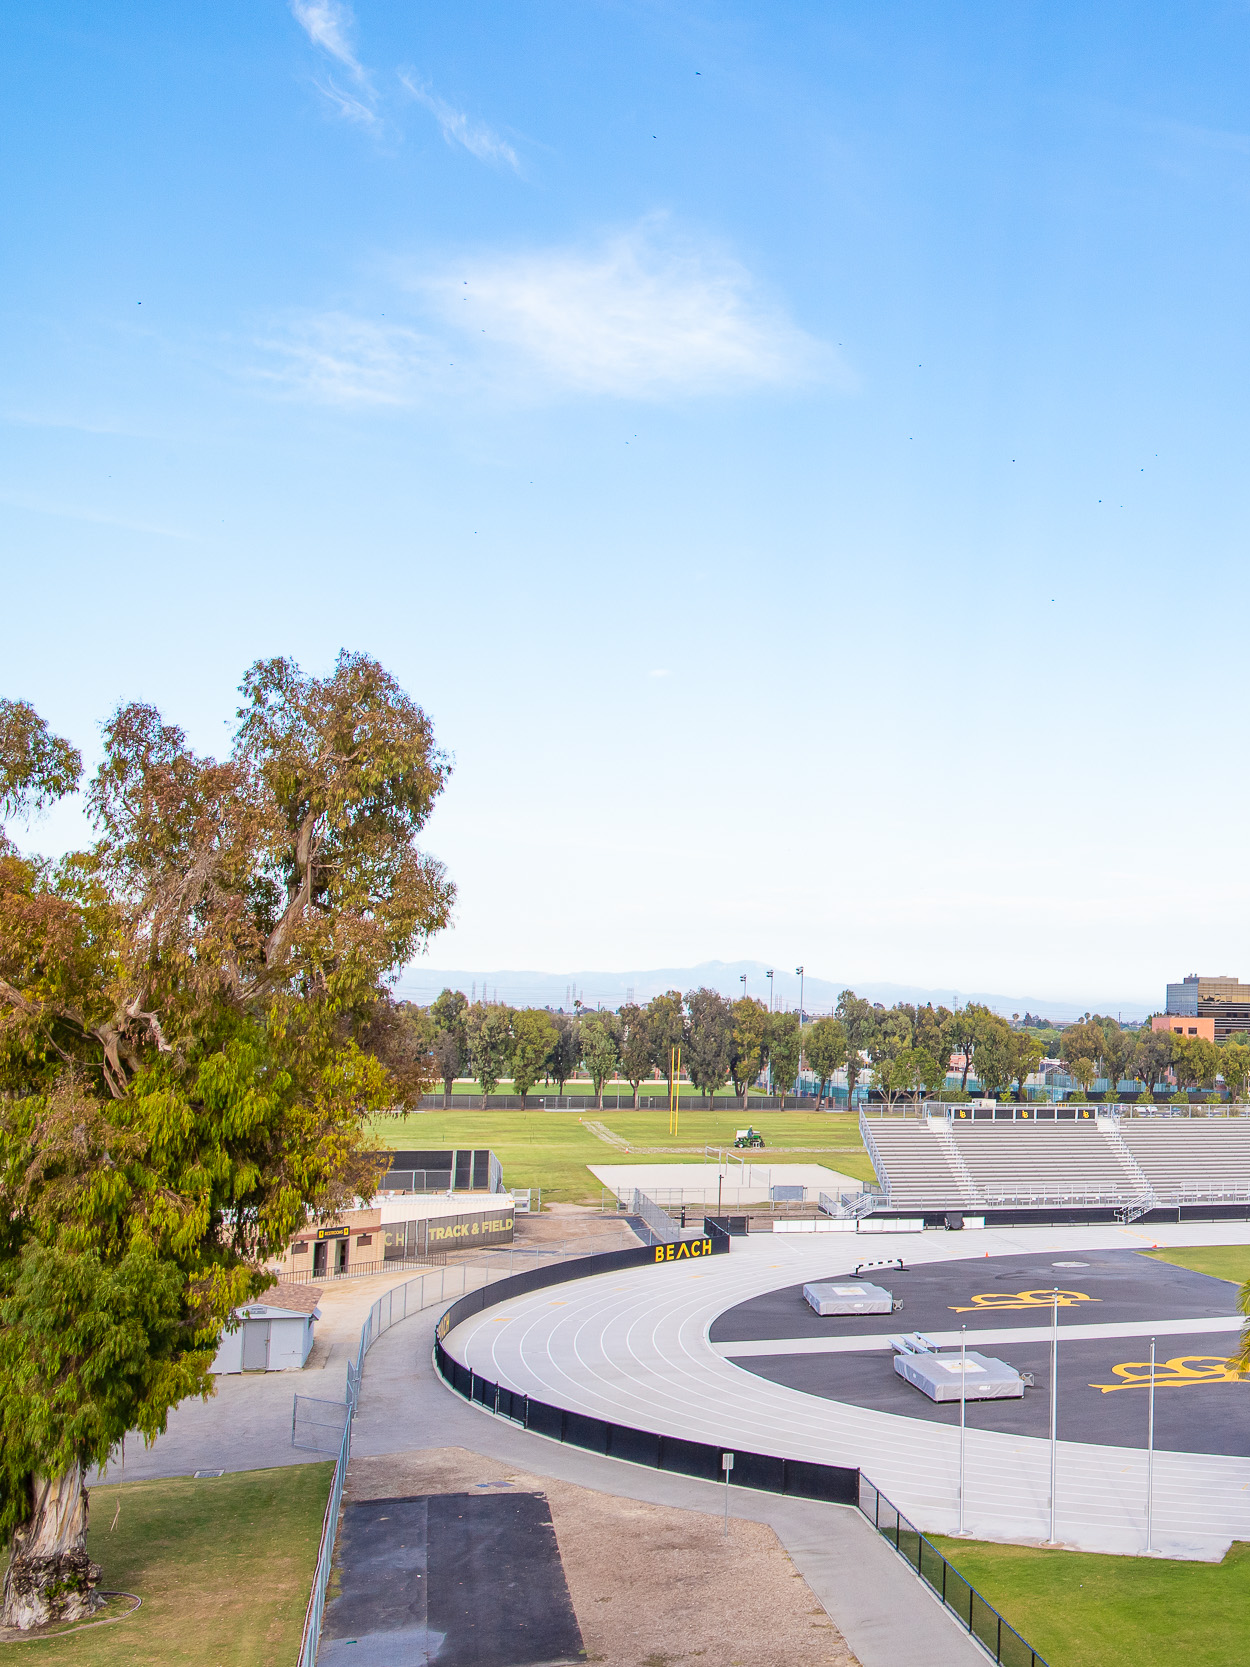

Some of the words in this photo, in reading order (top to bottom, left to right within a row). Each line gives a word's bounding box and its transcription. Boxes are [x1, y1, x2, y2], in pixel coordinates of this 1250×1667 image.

[429, 1224, 470, 1241] TRACK
[472, 1222, 479, 1235] &
[482, 1218, 514, 1235] FIELD
[655, 1239, 712, 1263] BEACH
